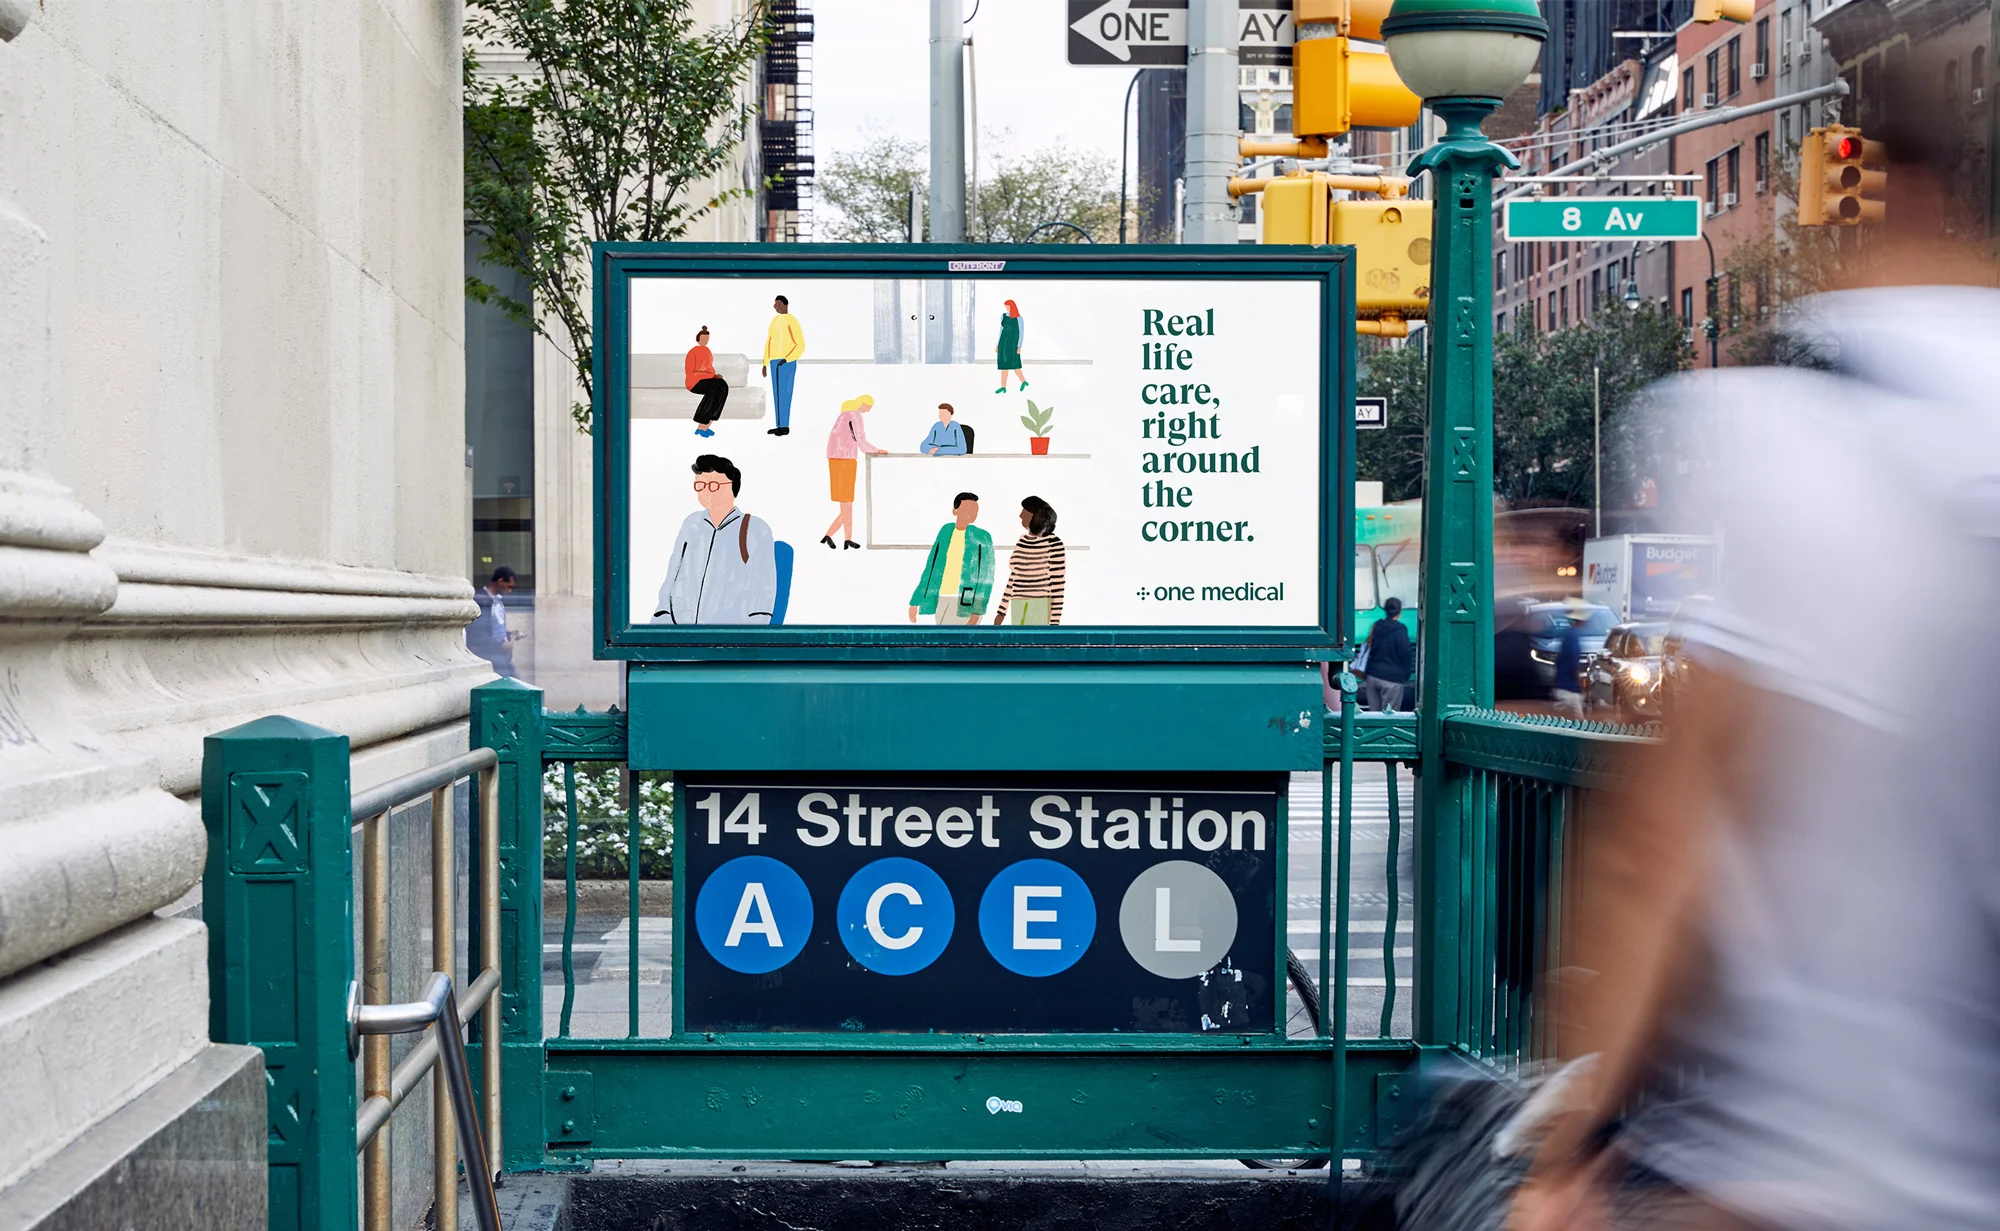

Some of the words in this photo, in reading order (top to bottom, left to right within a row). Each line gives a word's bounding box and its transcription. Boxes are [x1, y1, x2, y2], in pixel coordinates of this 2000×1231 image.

[1100, 12, 1170, 41] ONE
[1240, 13, 1288, 42] AY
[1562, 207, 1582, 231] 8
[1605, 207, 1644, 231] Av
[950, 262, 1003, 270] OUTFRONT
[1142, 307, 1215, 336] Real
[1142, 342, 1193, 370] life
[1142, 383, 1220, 409] care,
[1357, 408, 1373, 419] AY
[1142, 411, 1222, 446] right
[1142, 445, 1261, 474] around
[1142, 479, 1193, 508] the
[1142, 520, 1255, 543] corner.
[1647, 546, 1698, 563] Budget
[1597, 562, 1618, 592] Budget
[1154, 586, 1195, 601] one
[1201, 581, 1284, 602] medical
[695, 792, 767, 846] 14
[796, 792, 1001, 849] Street
[1029, 793, 1267, 852] Station
[724, 882, 784, 947] A
[865, 883, 924, 950] C
[1012, 886, 1062, 951] E
[1154, 887, 1201, 952] L
[1001, 1100, 1022, 1113] via
